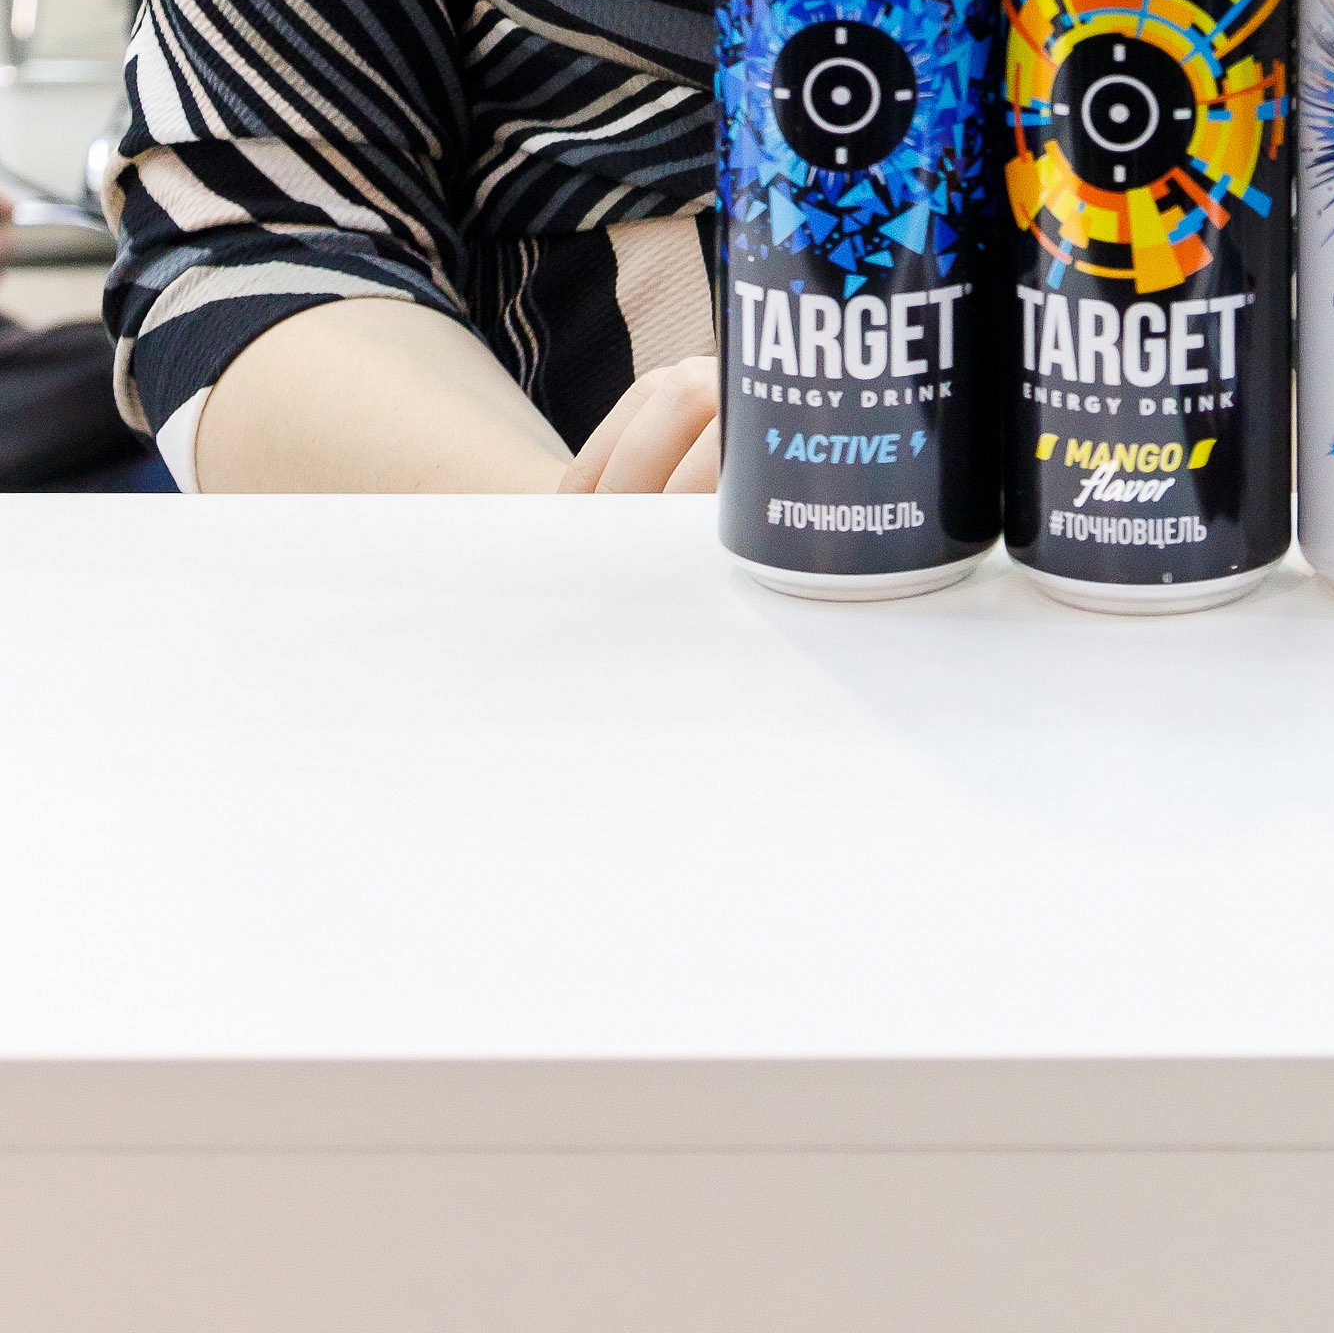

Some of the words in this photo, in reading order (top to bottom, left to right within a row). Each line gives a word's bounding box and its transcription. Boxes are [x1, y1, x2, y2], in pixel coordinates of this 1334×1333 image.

[735, 280, 963, 380] TARGET
[1016, 285, 1246, 388] TARGET
[741, 377, 843, 408] ENERGY
[860, 381, 953, 409] DRINK
[1022, 384, 1122, 415] ENERGY
[1139, 390, 1235, 416] DRINK
[784, 433, 902, 465] ACTIVE
[1064, 437, 1184, 473] MANGO
[1073, 459, 1177, 508] flavor
[766, 498, 925, 535] #ТОЧНОВЦЕЛЬ
[1049, 510, 1208, 549] #ТОЧНОВЦЕЛЬ
